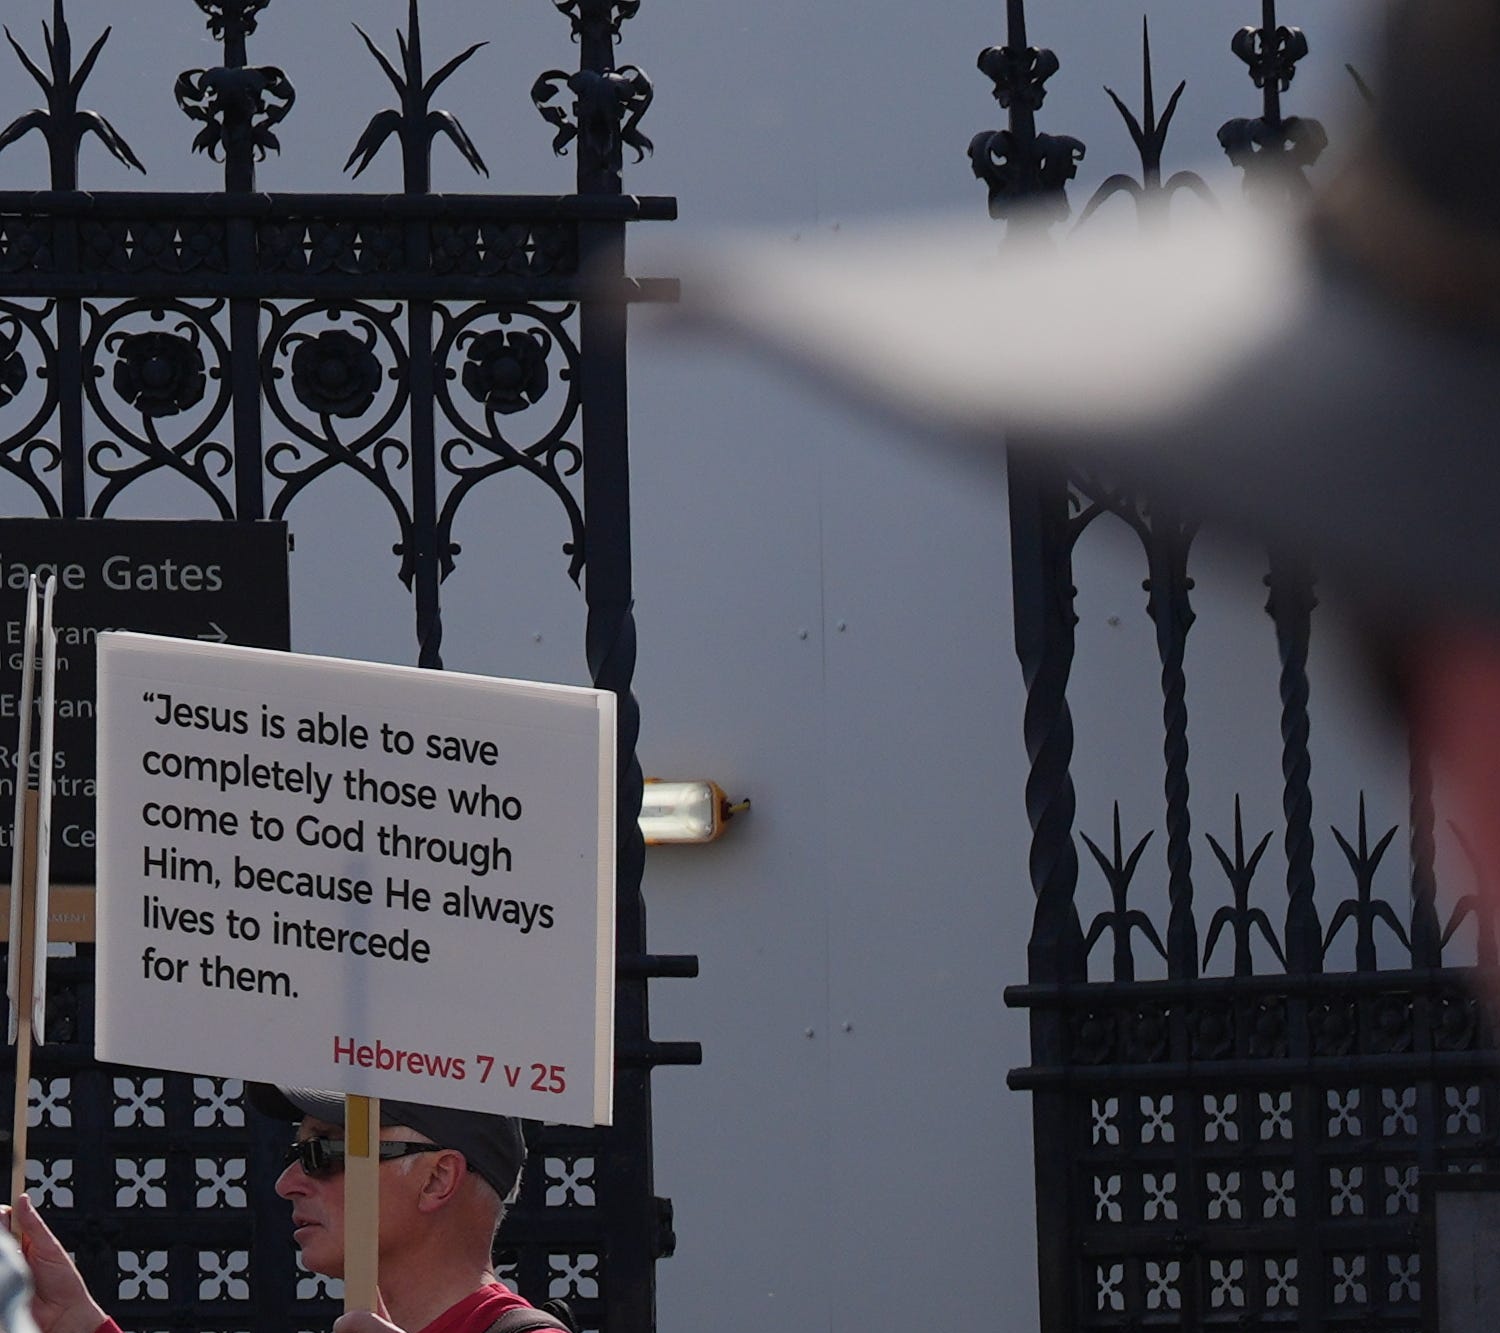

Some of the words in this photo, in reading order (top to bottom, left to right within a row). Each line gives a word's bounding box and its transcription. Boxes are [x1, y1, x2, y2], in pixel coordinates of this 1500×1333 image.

[102, 555, 223, 592] Gates
[262, 704, 285, 739] is
[297, 712, 368, 749] able
[380, 723, 414, 755] to
[426, 734, 498, 765] save
[143, 751, 333, 804] completely
[344, 769, 436, 809] those
[448, 784, 522, 820] who
[143, 803, 238, 836] come
[250, 810, 284, 841] to
[296, 815, 364, 852] God
[377, 825, 512, 876] through
[144, 846, 220, 889] Him,
[235, 856, 373, 904] because
[386, 877, 430, 911] He
[442, 886, 554, 934] always
[144, 895, 214, 935] lives
[226, 909, 260, 941] to
[274, 911, 430, 963] intercede
[142, 947, 189, 983] for
[200, 955, 298, 998] them.
[333, 1035, 466, 1080] Hebrews
[476, 1055, 495, 1084] 7
[504, 1065, 521, 1087] v
[530, 1063, 566, 1094] 25
